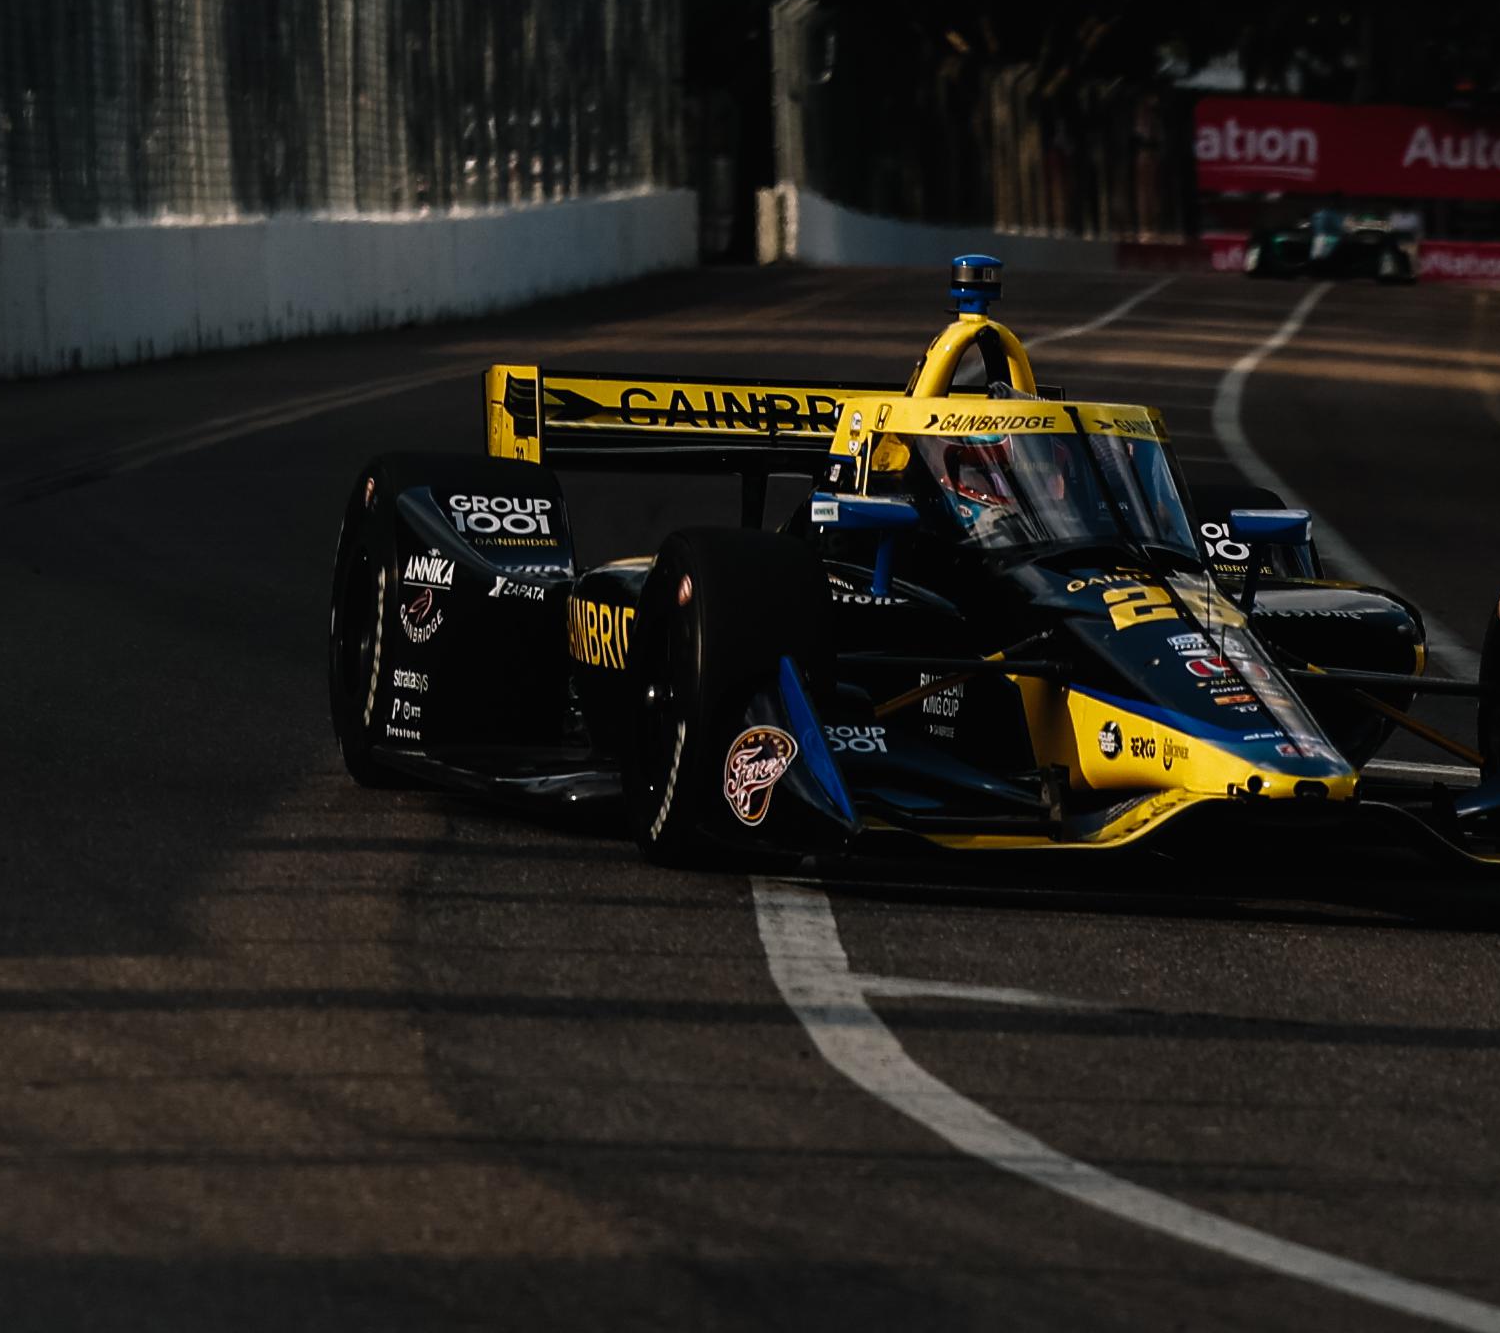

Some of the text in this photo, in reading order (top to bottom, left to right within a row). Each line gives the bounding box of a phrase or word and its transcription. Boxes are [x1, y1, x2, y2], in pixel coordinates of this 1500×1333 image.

[940, 414, 1056, 431] GAINBRIDGE
[449, 494, 552, 514] GROUP
[452, 511, 551, 534] 1001
[404, 555, 456, 585] ANNIKA
[503, 586, 545, 601] ZAPATA
[393, 669, 429, 693] stratasys
[923, 695, 960, 718] KING CUP
[386, 724, 421, 740] Firestone
